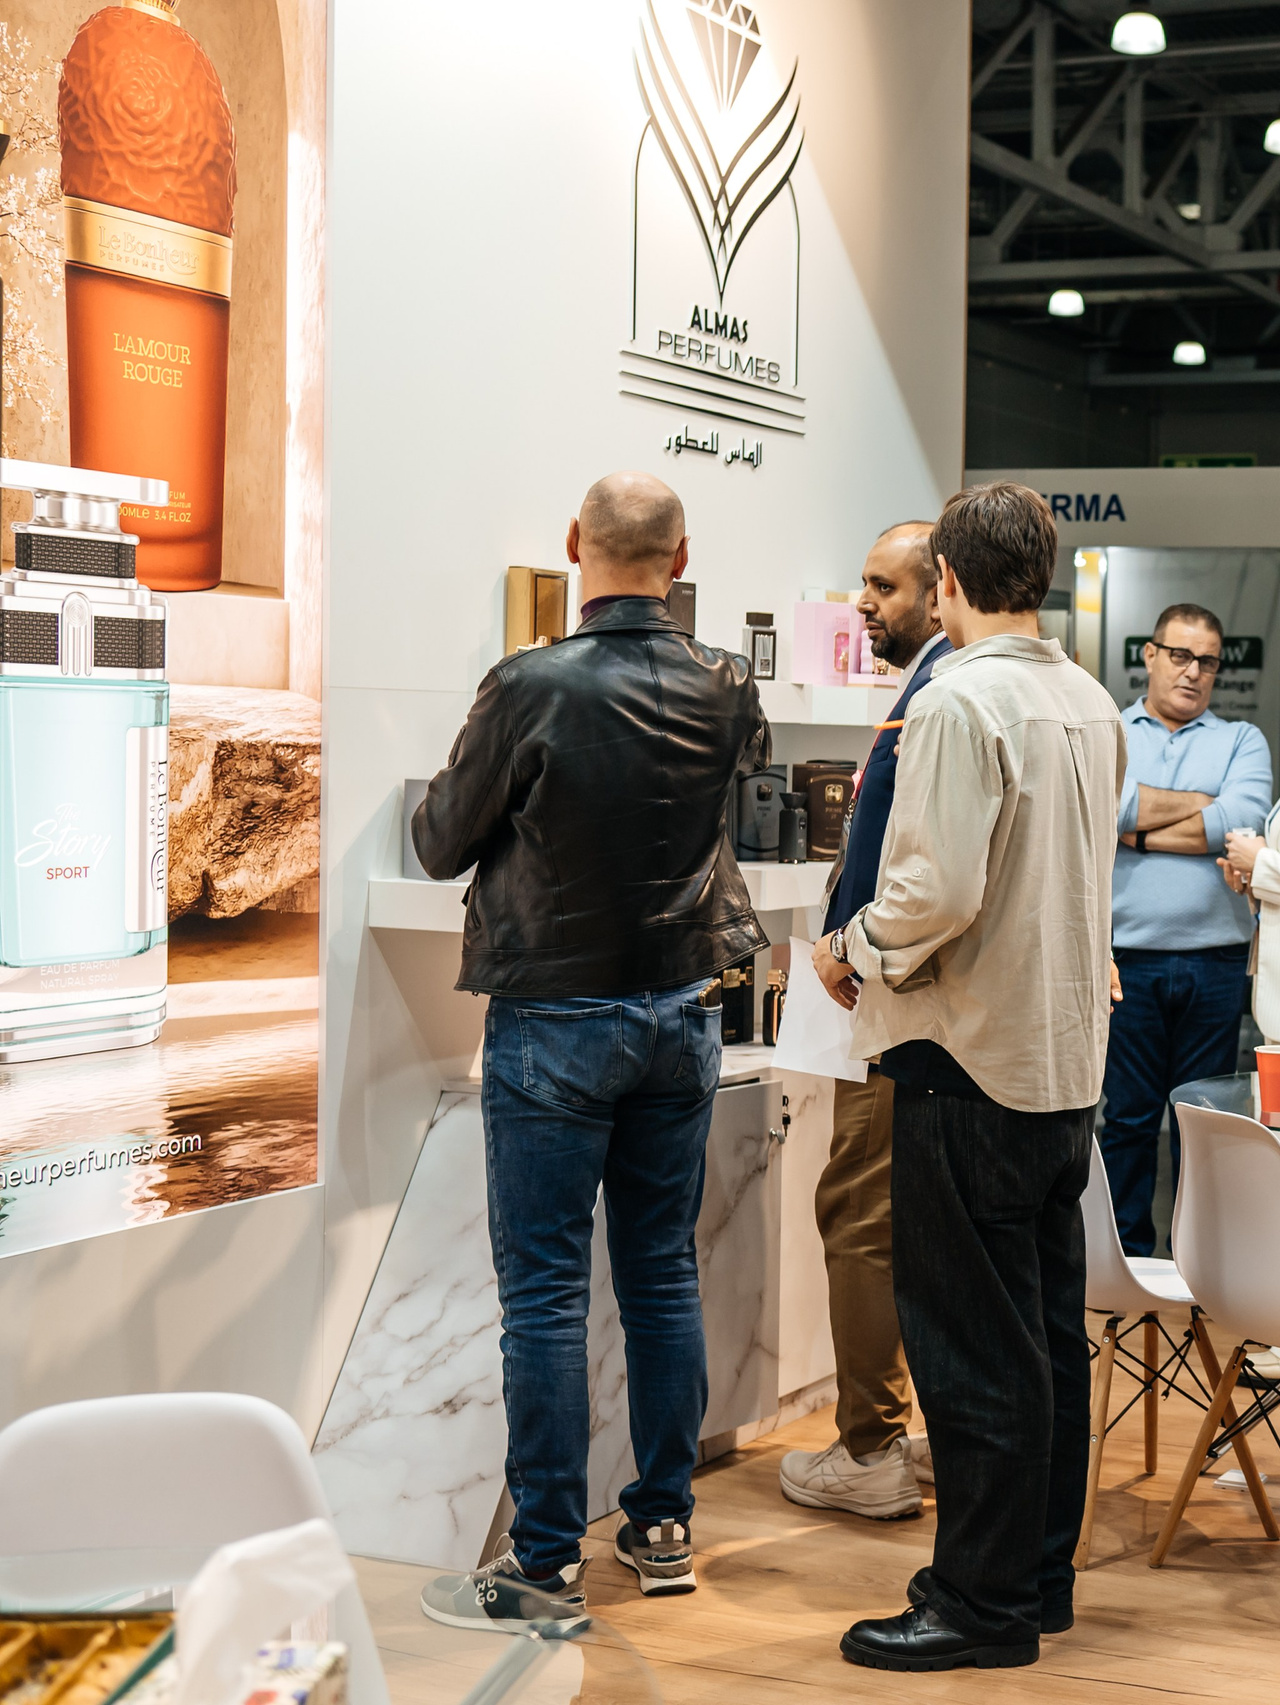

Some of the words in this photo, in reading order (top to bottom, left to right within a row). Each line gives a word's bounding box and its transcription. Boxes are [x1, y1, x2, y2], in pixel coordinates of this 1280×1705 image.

[689, 304, 749, 344] ALMAS
[113, 332, 192, 366] L'AMOUR
[656, 329, 781, 384] PERFUMES
[122, 360, 183, 388] ROUGE
[168, 491, 186, 500] FUM
[1042, 493, 1127, 523] RMA
[14, 819, 112, 872] Story
[46, 865, 91, 880] SPORT
[40, 964, 61, 977] EAU
[63, 963, 78, 974] DE
[40, 976, 86, 990] NATURAL
[88, 972, 120, 985] SPRAY
